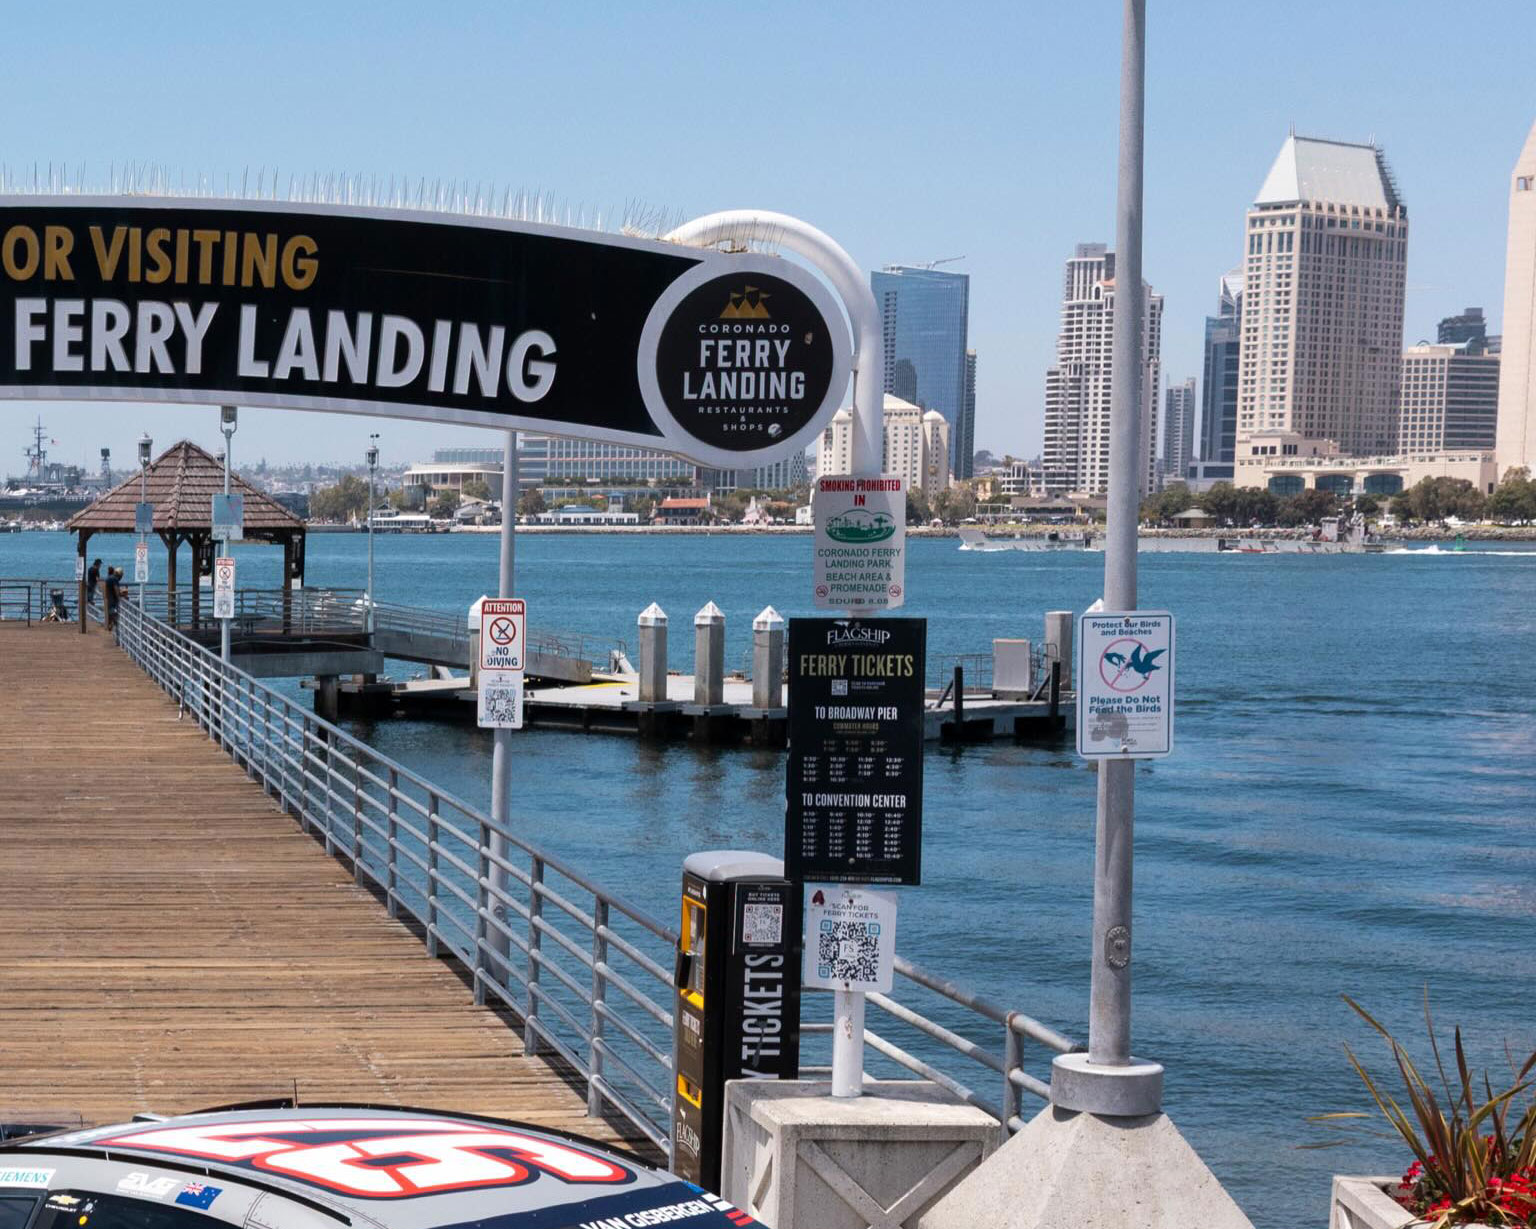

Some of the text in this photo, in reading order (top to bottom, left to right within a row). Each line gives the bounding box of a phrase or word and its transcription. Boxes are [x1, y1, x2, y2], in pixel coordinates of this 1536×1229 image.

[90, 225, 321, 290] VISITING
[699, 324, 791, 334] CORONADO
[14, 297, 219, 375] FERRY
[237, 303, 559, 402] LANDING
[700, 339, 792, 368] FERRY
[683, 371, 806, 400] LANDING
[698, 406, 790, 414] RESTAURANTS
[723, 424, 764, 432] SHOPS
[820, 479, 901, 492] SMOKING PROHIBITED
[854, 495, 866, 506] IN
[818, 548, 901, 558] CORONADO FERRY
[825, 559, 865, 569] LANDING
[826, 573, 892, 581] BEACH AREA &
[830, 584, 887, 593] PROMENADE
[484, 602, 523, 613] ATTENTION
[1092, 621, 1122, 629] Protect
[1140, 620, 1161, 628] Birds
[827, 628, 891, 644] FLAGSHIP
[1101, 628, 1152, 636] and Beaches
[496, 647, 509, 656] NO
[487, 658, 518, 667] DIVING
[800, 654, 914, 677] FERRY TICKETS
[1090, 695, 1161, 705] Please Do Not
[815, 706, 898, 720] TO BROADWAY PIER
[1089, 704, 1162, 714] Feed the Birds
[802, 793, 906, 808] TO CONVENTION CENTER
[741, 954, 784, 1060] TICKETS
[676, 1121, 700, 1155] FLAGSHIP
[93, 1118, 637, 1200] 97
[624, 1200, 715, 1228] GISBERGEN
